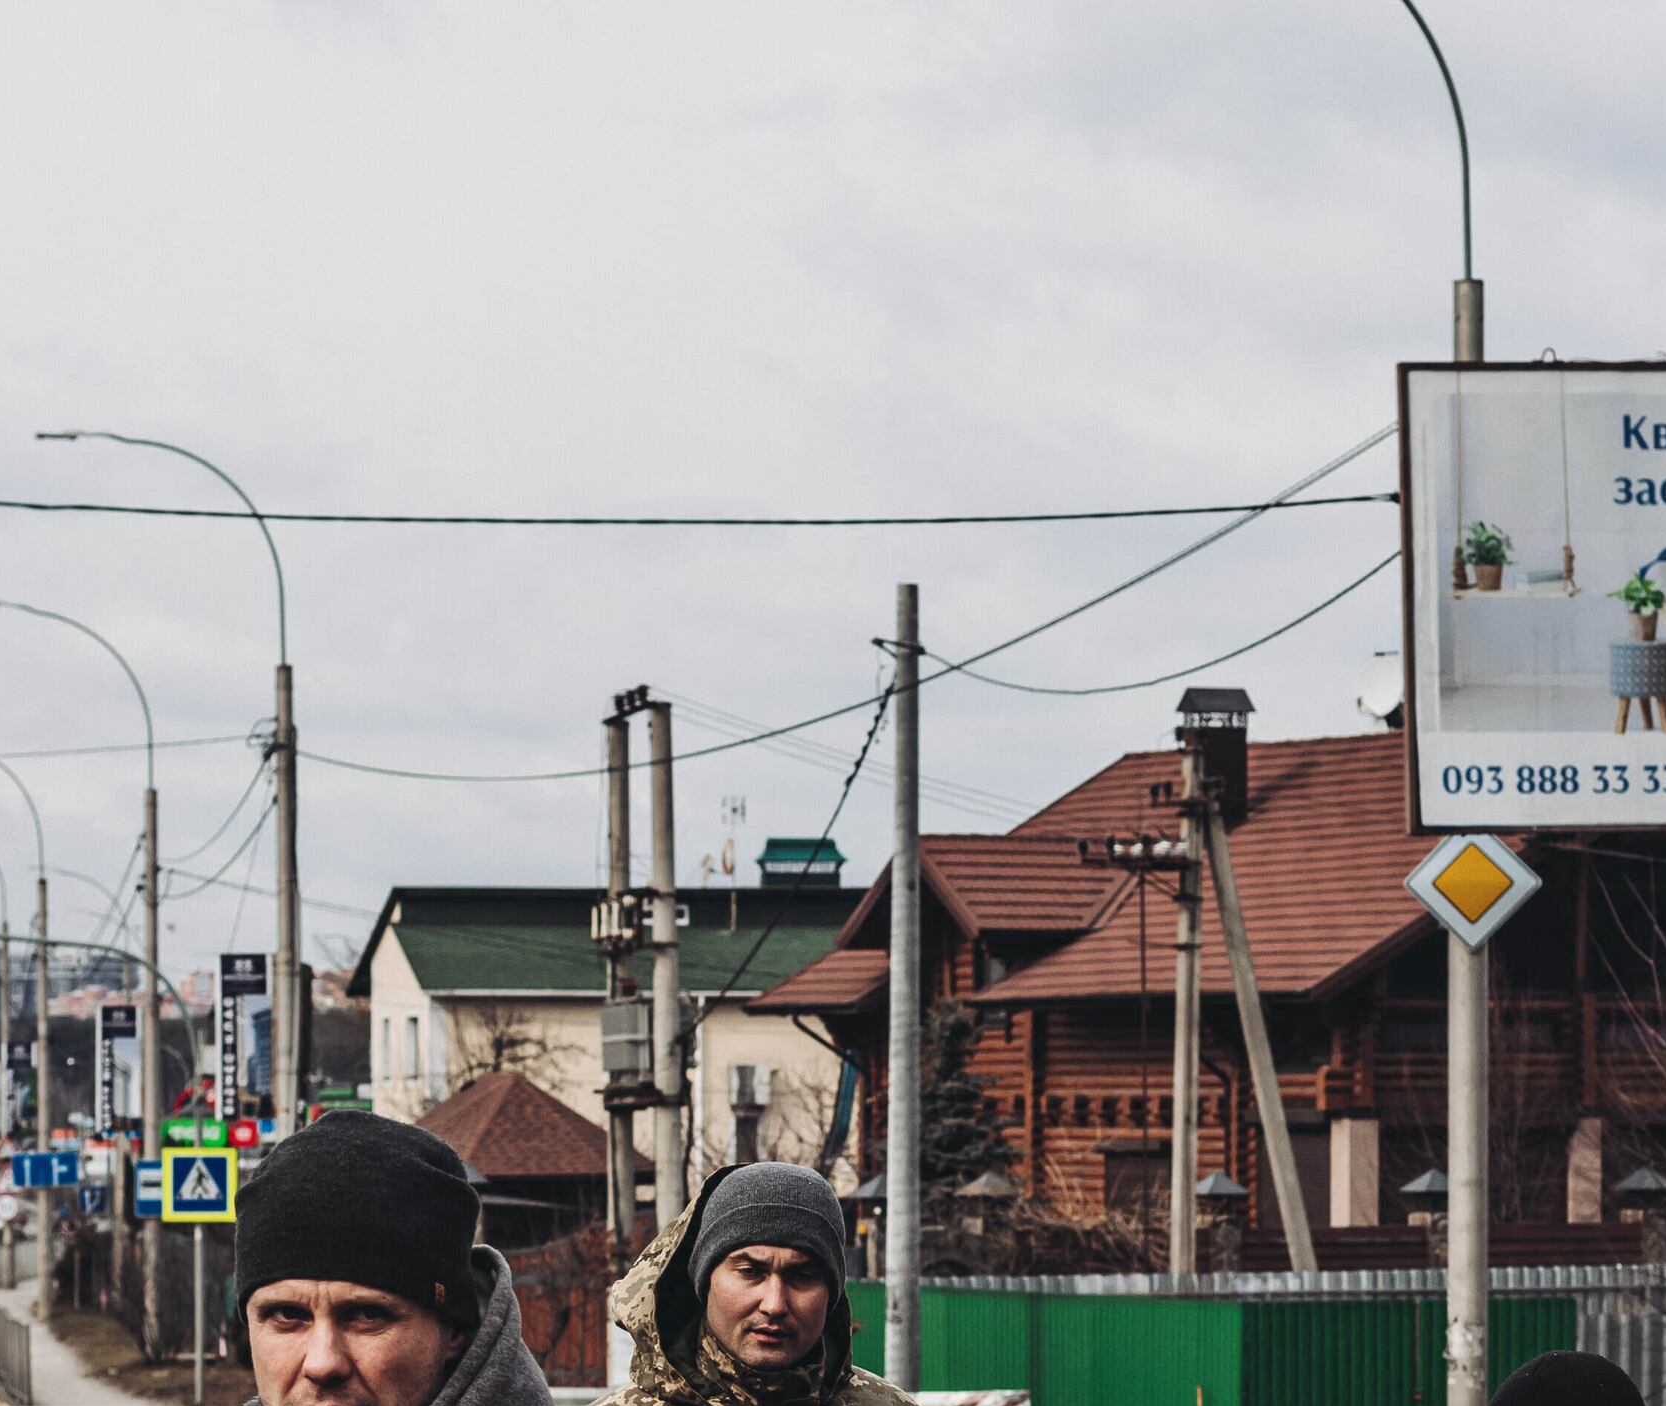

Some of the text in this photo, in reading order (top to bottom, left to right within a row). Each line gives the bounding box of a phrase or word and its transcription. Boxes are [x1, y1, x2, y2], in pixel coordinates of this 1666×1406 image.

[1442, 765, 1504, 795] 093
[1516, 765, 1580, 795] 888
[1591, 765, 1630, 795] 33
